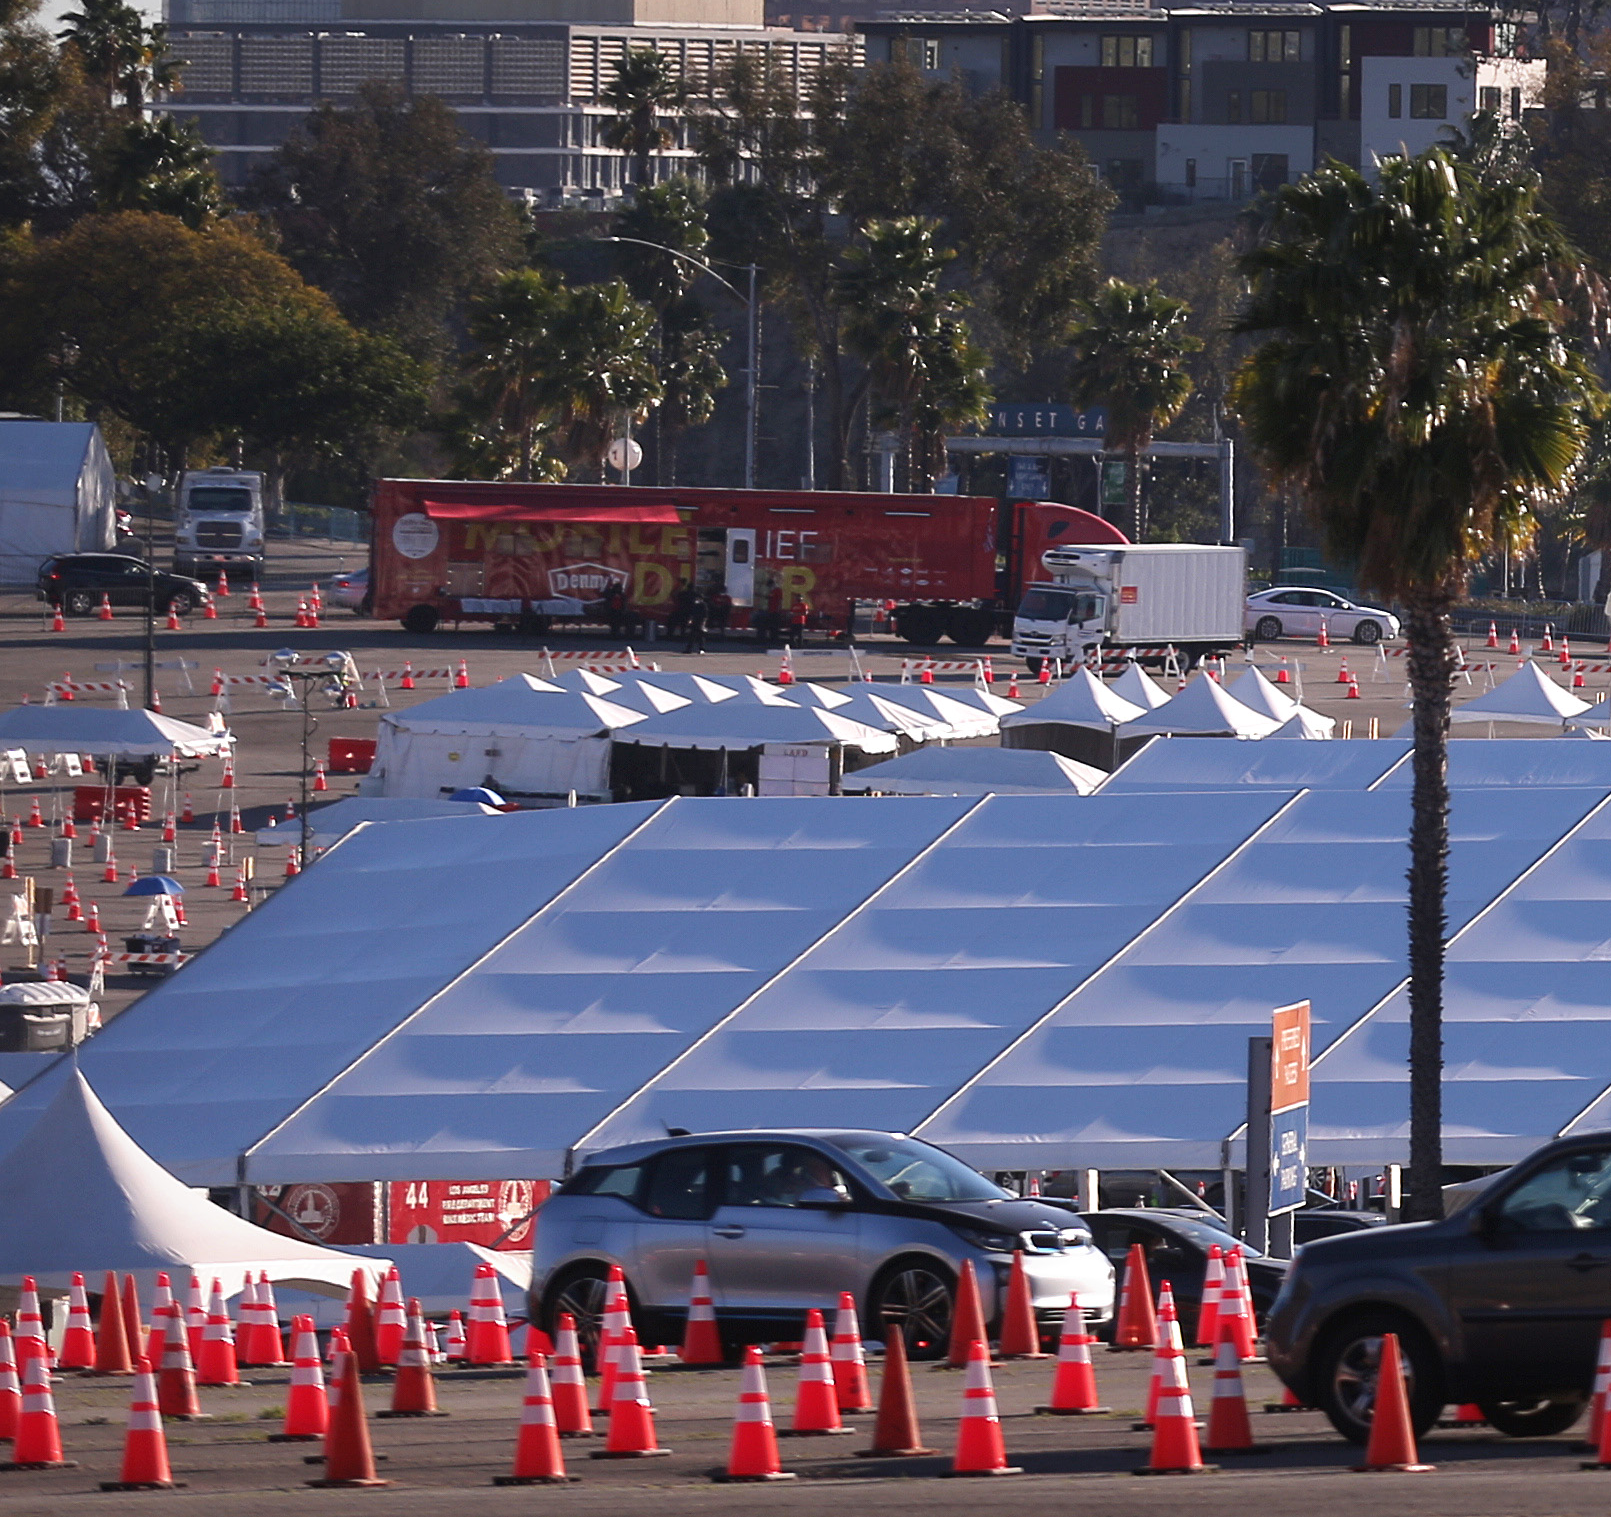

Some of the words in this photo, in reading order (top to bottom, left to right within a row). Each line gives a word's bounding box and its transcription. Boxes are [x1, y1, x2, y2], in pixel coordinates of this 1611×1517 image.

[999, 412, 1057, 428] NSET
[1077, 415, 1104, 430] GA
[406, 1182, 428, 1209] 44
